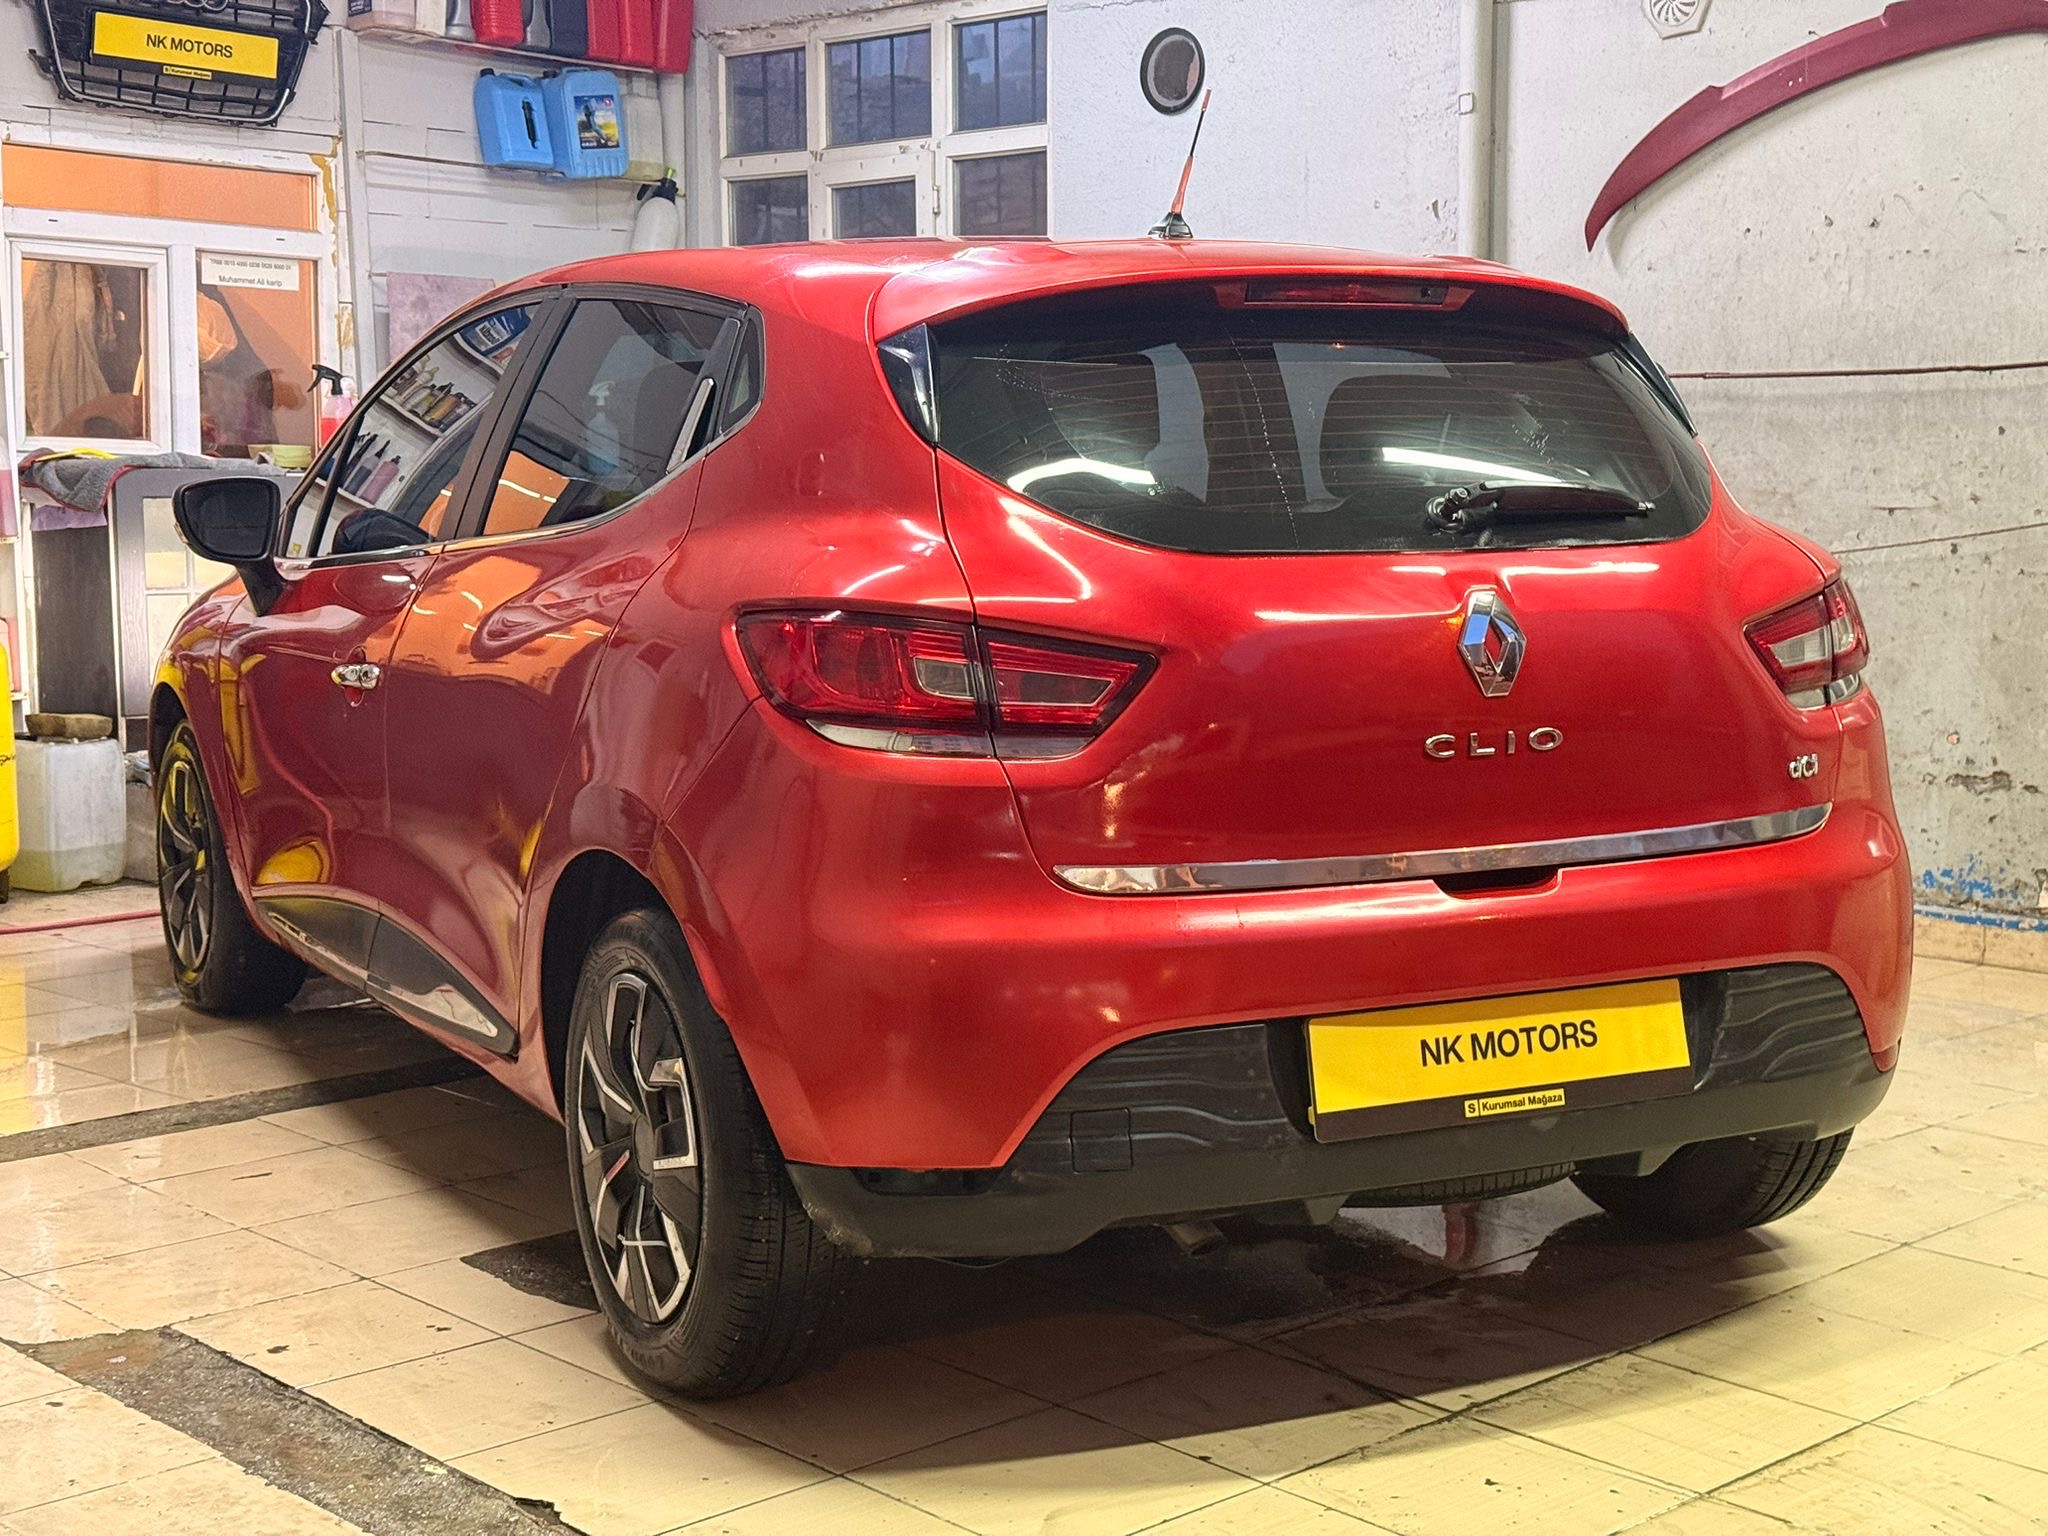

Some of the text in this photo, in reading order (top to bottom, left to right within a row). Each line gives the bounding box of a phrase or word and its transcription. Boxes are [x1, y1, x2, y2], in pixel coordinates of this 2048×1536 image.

[146, 33, 233, 59] NK MOTORS
[218, 275, 256, 285] Muhammet
[1424, 726, 1565, 759] CLIO
[1420, 1019, 1598, 1067] NK MOTORS
[1467, 1093, 1564, 1114] S Kurumsal Mağaza
